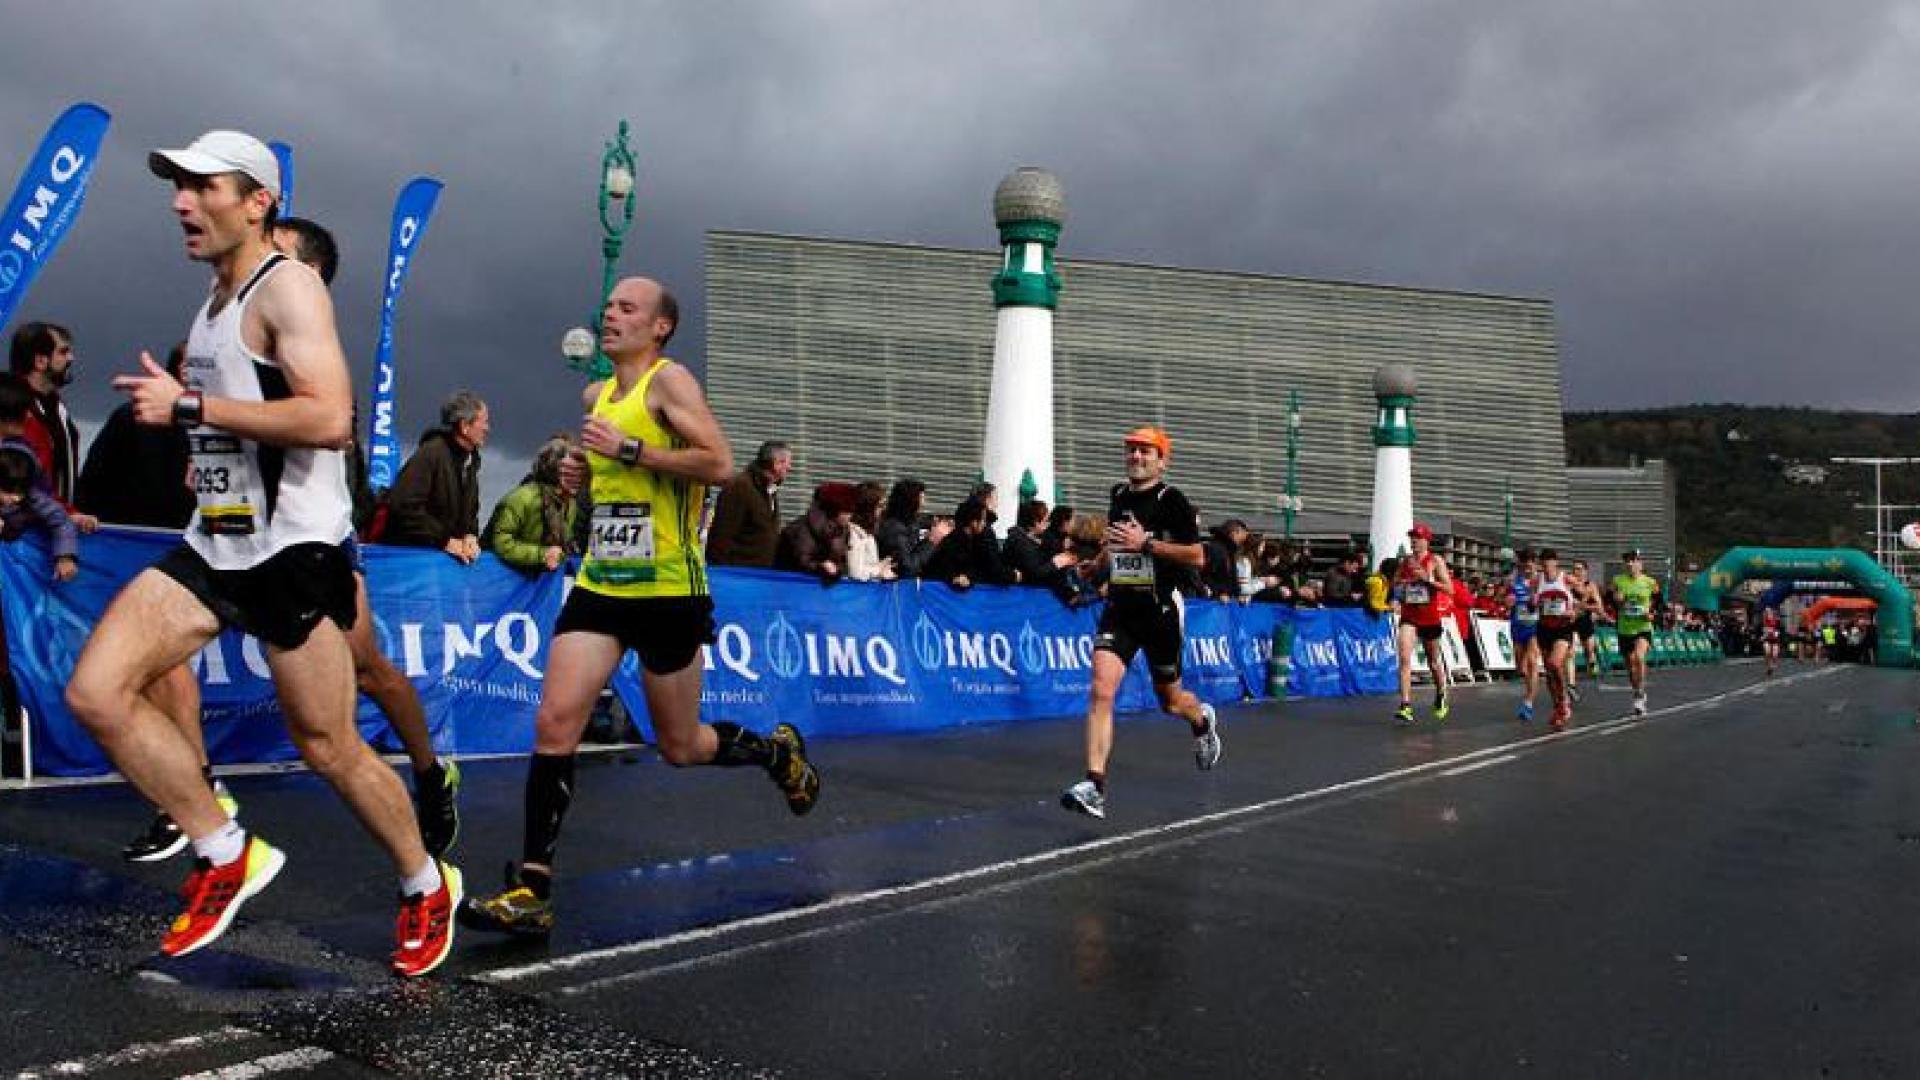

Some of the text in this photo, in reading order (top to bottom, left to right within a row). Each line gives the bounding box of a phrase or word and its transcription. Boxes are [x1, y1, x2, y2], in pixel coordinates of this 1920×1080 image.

[10, 145, 86, 251] IMQ
[593, 524, 642, 547] 1447
[805, 632, 906, 684] IMQ
[945, 630, 1017, 676] IMQ
[1190, 635, 1235, 670] IMQ
